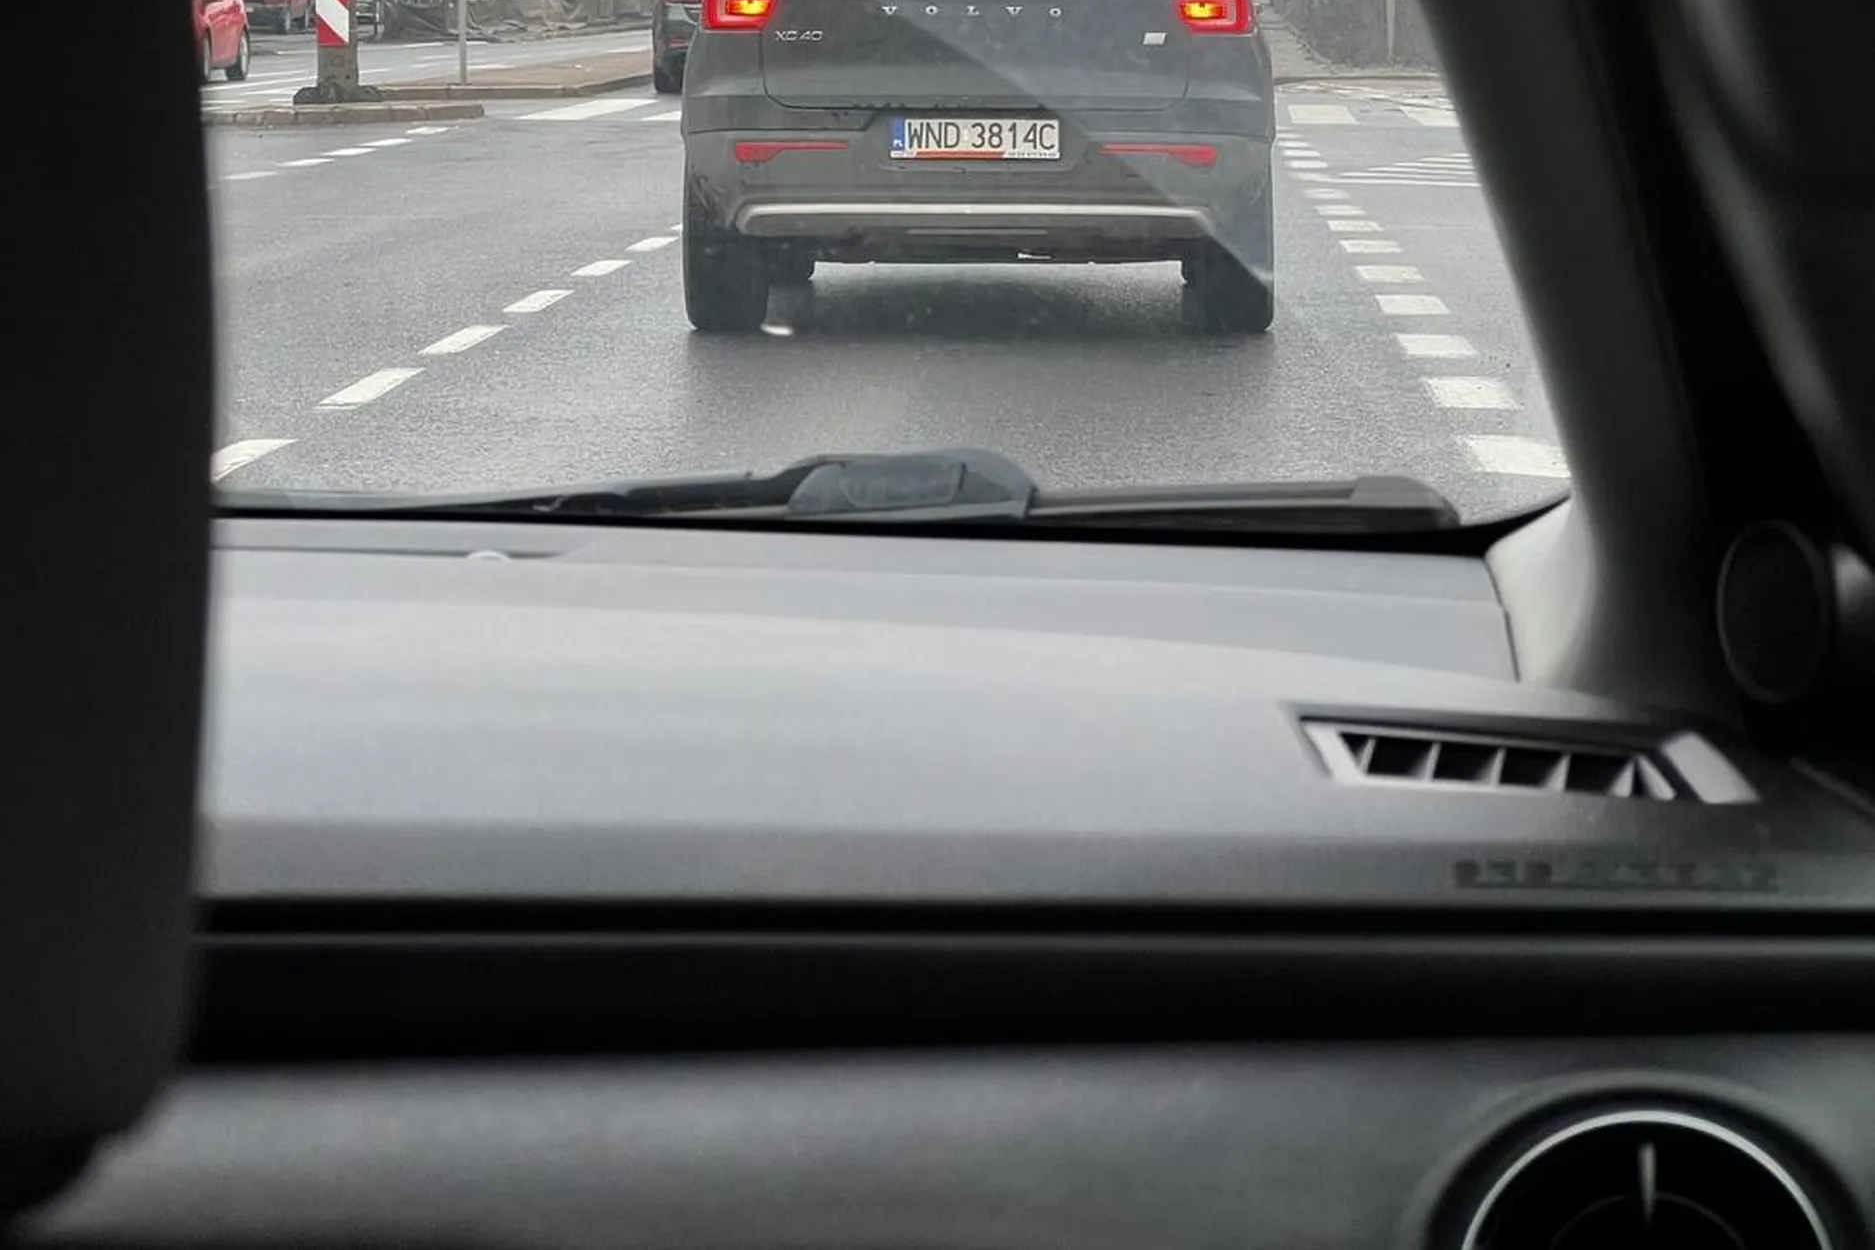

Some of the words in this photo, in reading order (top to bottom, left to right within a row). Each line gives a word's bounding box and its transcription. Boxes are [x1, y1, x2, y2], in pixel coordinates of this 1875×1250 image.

[882, 6, 1062, 17] VOLVO
[908, 122, 960, 148] WND
[972, 122, 1056, 150] 3814C
